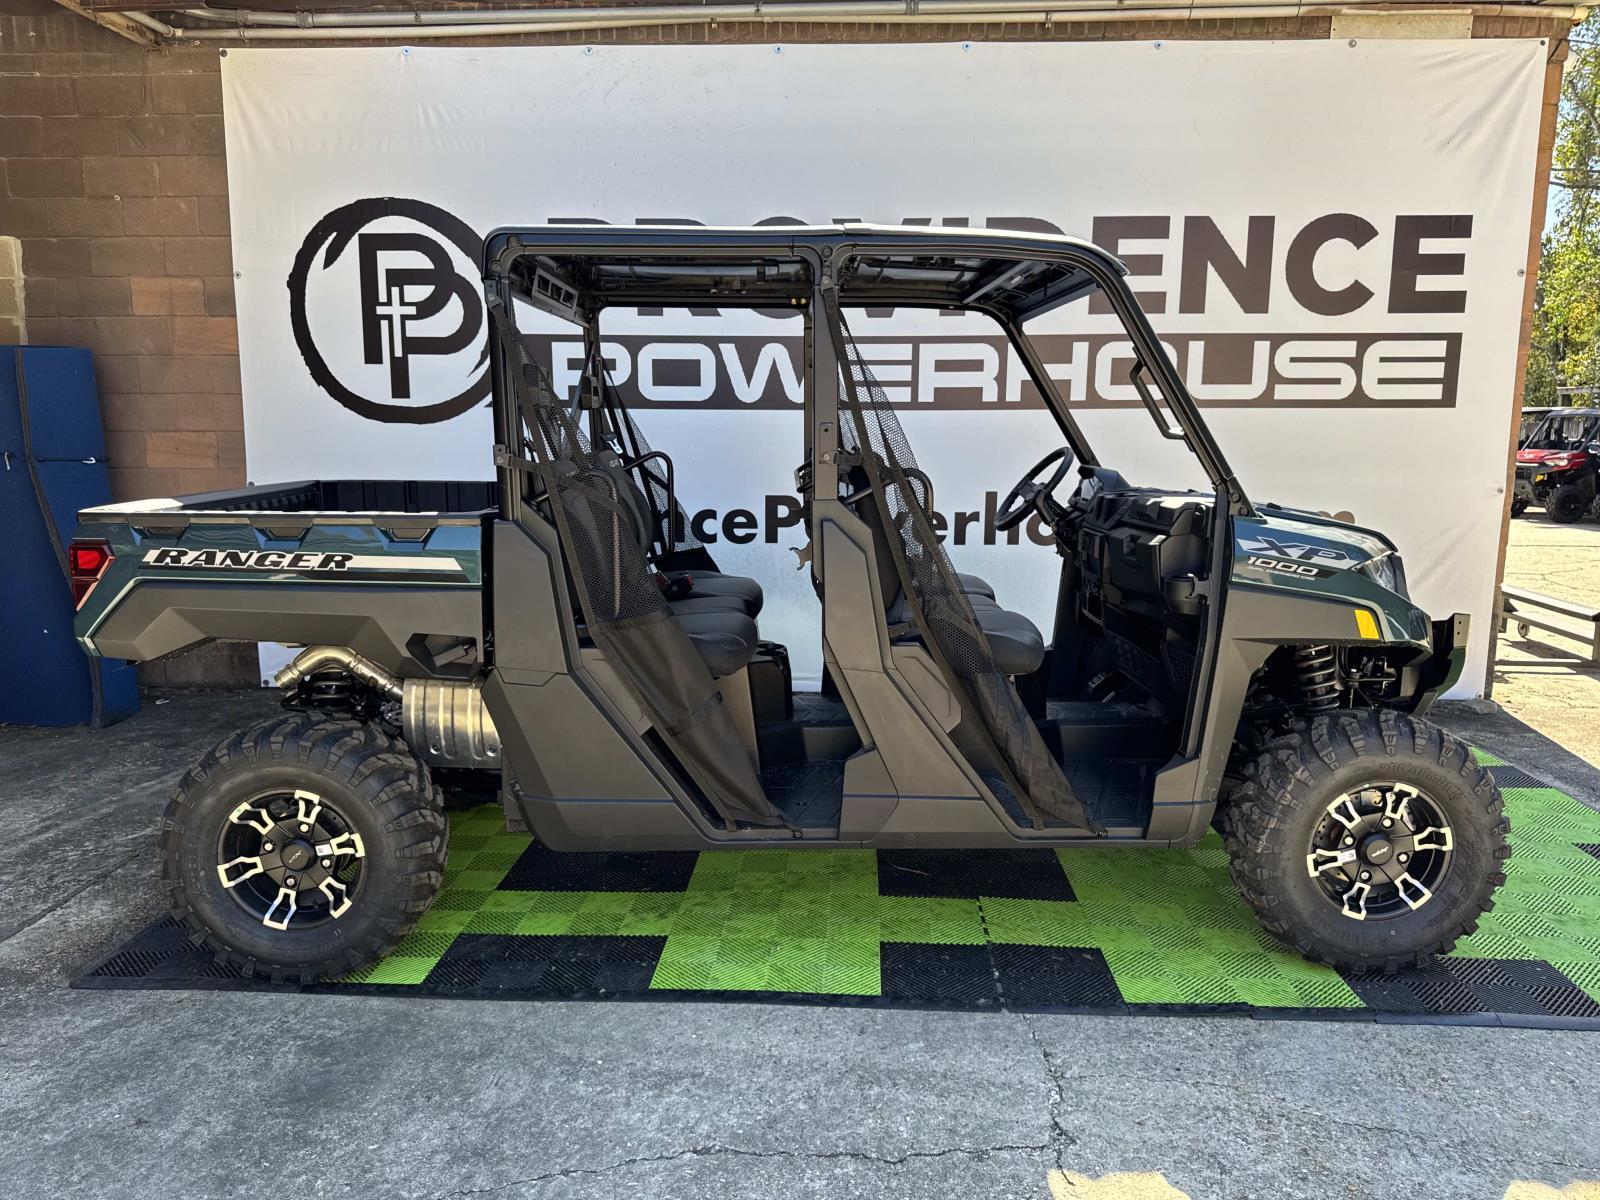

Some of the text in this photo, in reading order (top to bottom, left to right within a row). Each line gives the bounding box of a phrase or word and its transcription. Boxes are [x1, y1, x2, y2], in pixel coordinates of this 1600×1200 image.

[551, 340, 1447, 404] POWERHOUSE
[150, 547, 354, 571] RANGER
[1240, 536, 1356, 568] XP
[1247, 556, 1319, 576] 1000
